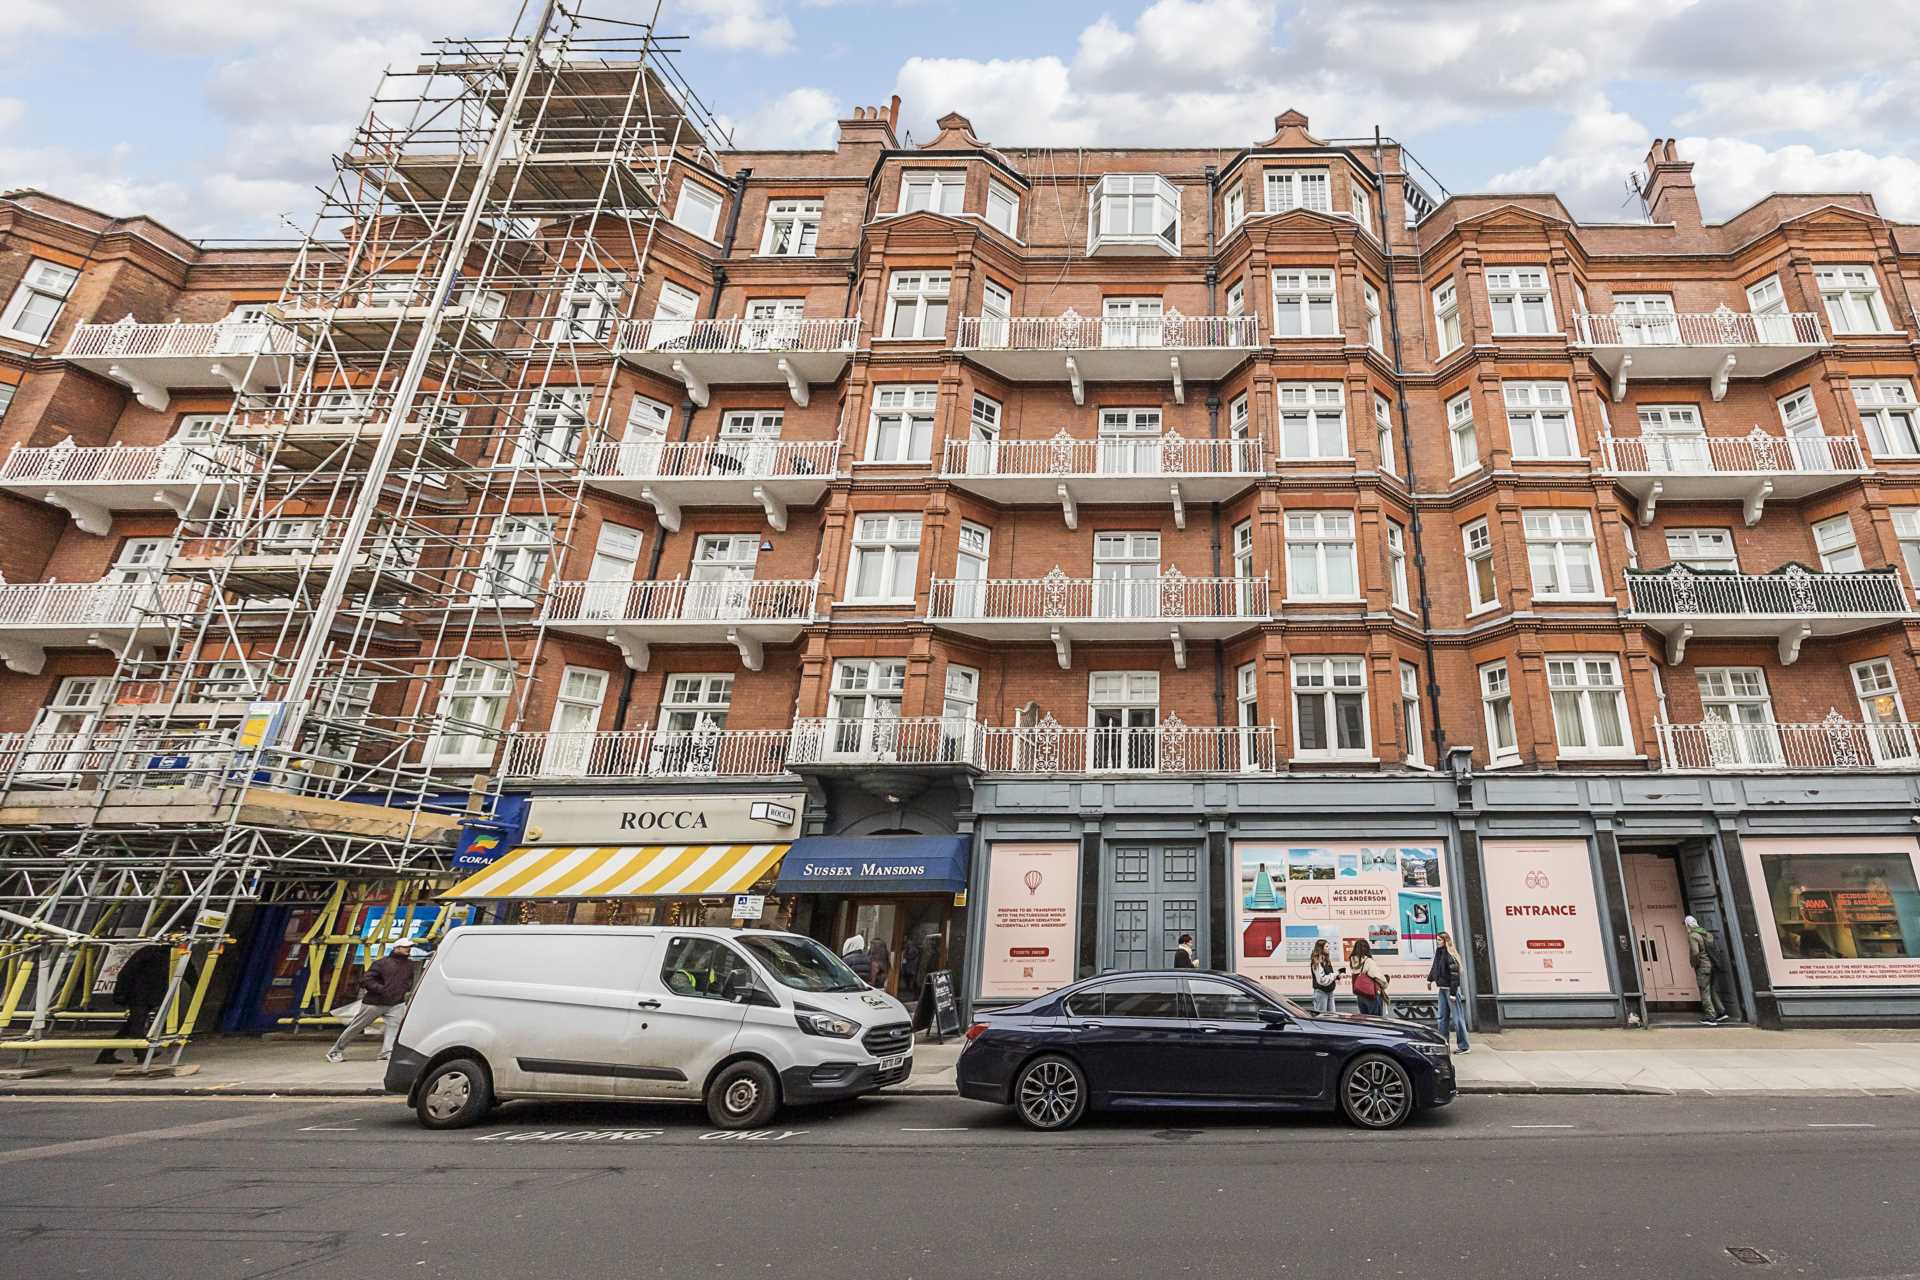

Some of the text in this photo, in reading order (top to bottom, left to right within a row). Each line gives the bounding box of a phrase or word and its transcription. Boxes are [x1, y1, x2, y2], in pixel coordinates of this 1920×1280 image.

[770, 808, 792, 820] ROCCA
[620, 811, 708, 830] ROCCA
[459, 855, 494, 865] CORAL
[1300, 896, 1323, 905] AWA
[1505, 905, 1577, 916] ENTRANCE
[473, 1130, 811, 1141] LOADING ONLY
